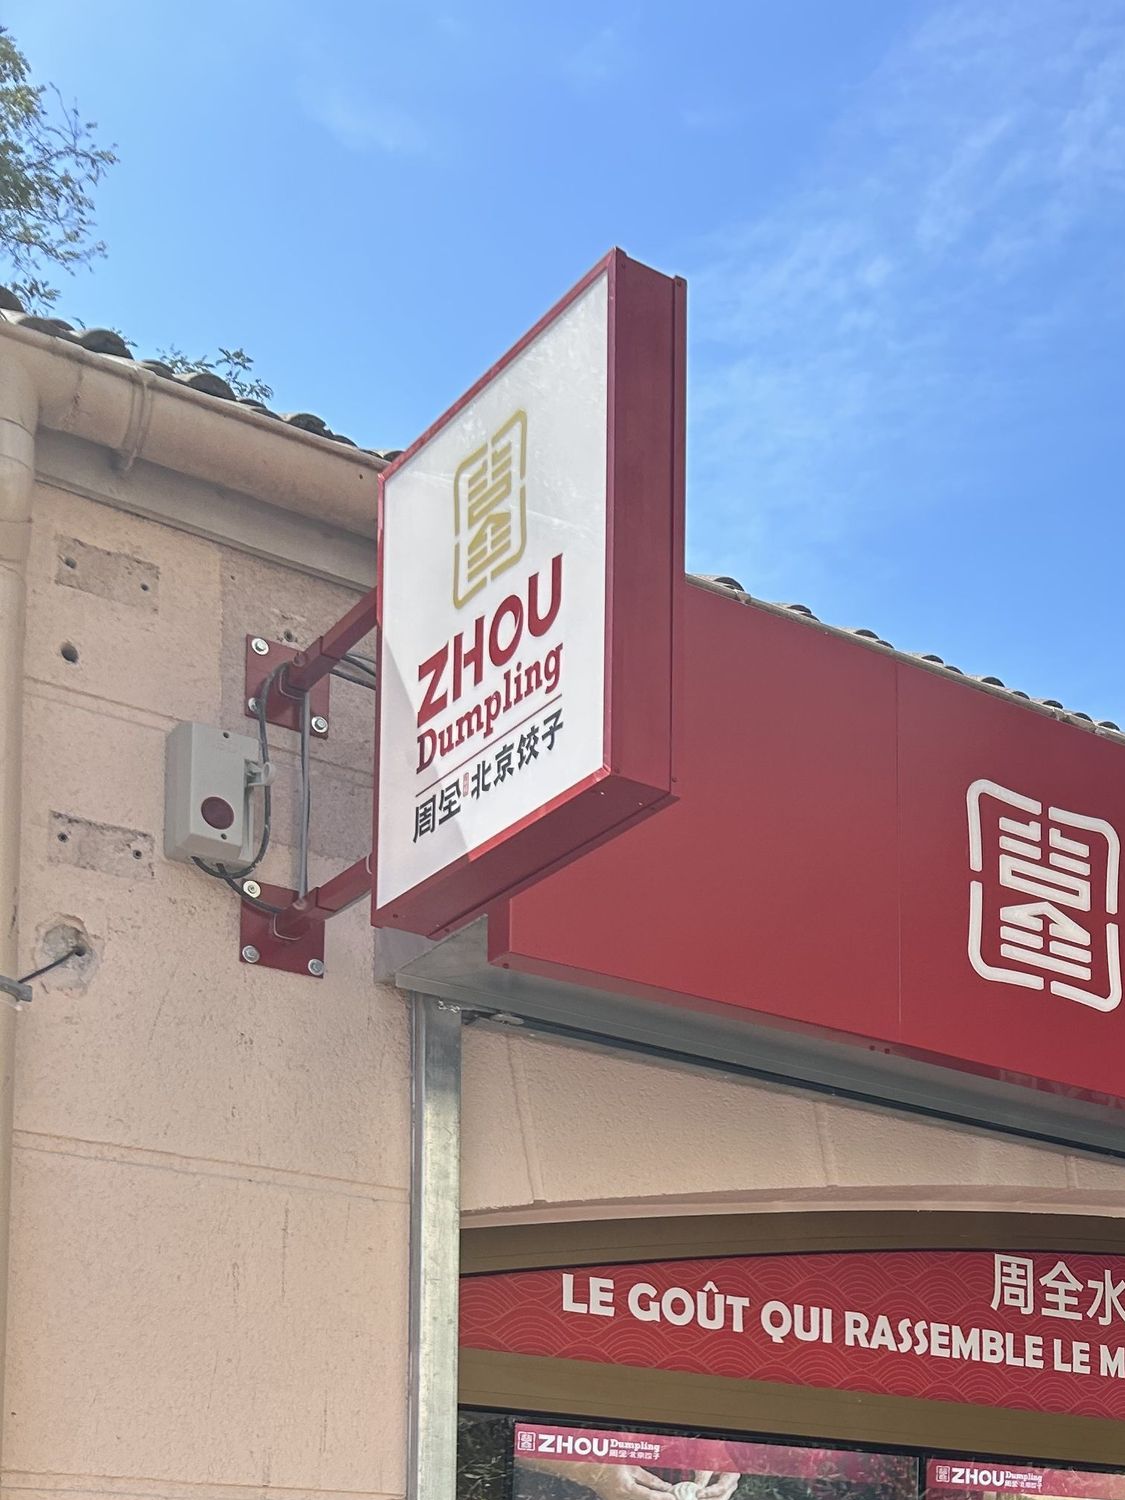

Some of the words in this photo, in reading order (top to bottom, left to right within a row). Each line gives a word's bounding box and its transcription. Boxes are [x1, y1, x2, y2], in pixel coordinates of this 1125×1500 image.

[417, 553, 563, 728] ZHOU
[416, 643, 563, 774] Dumpling
[470, 708, 563, 800] 北京饺子
[561, 1272, 616, 1317] LE
[627, 1281, 750, 1333] GOÛT
[760, 1300, 833, 1346] QUI
[845, 1310, 1044, 1370] RASSEMBLE
[1053, 1337, 1091, 1377] LE
[538, 1434, 609, 1457] ZHOU
[609, 1438, 660, 1452] Dumpling
[952, 1467, 1005, 1487] ZHOU
